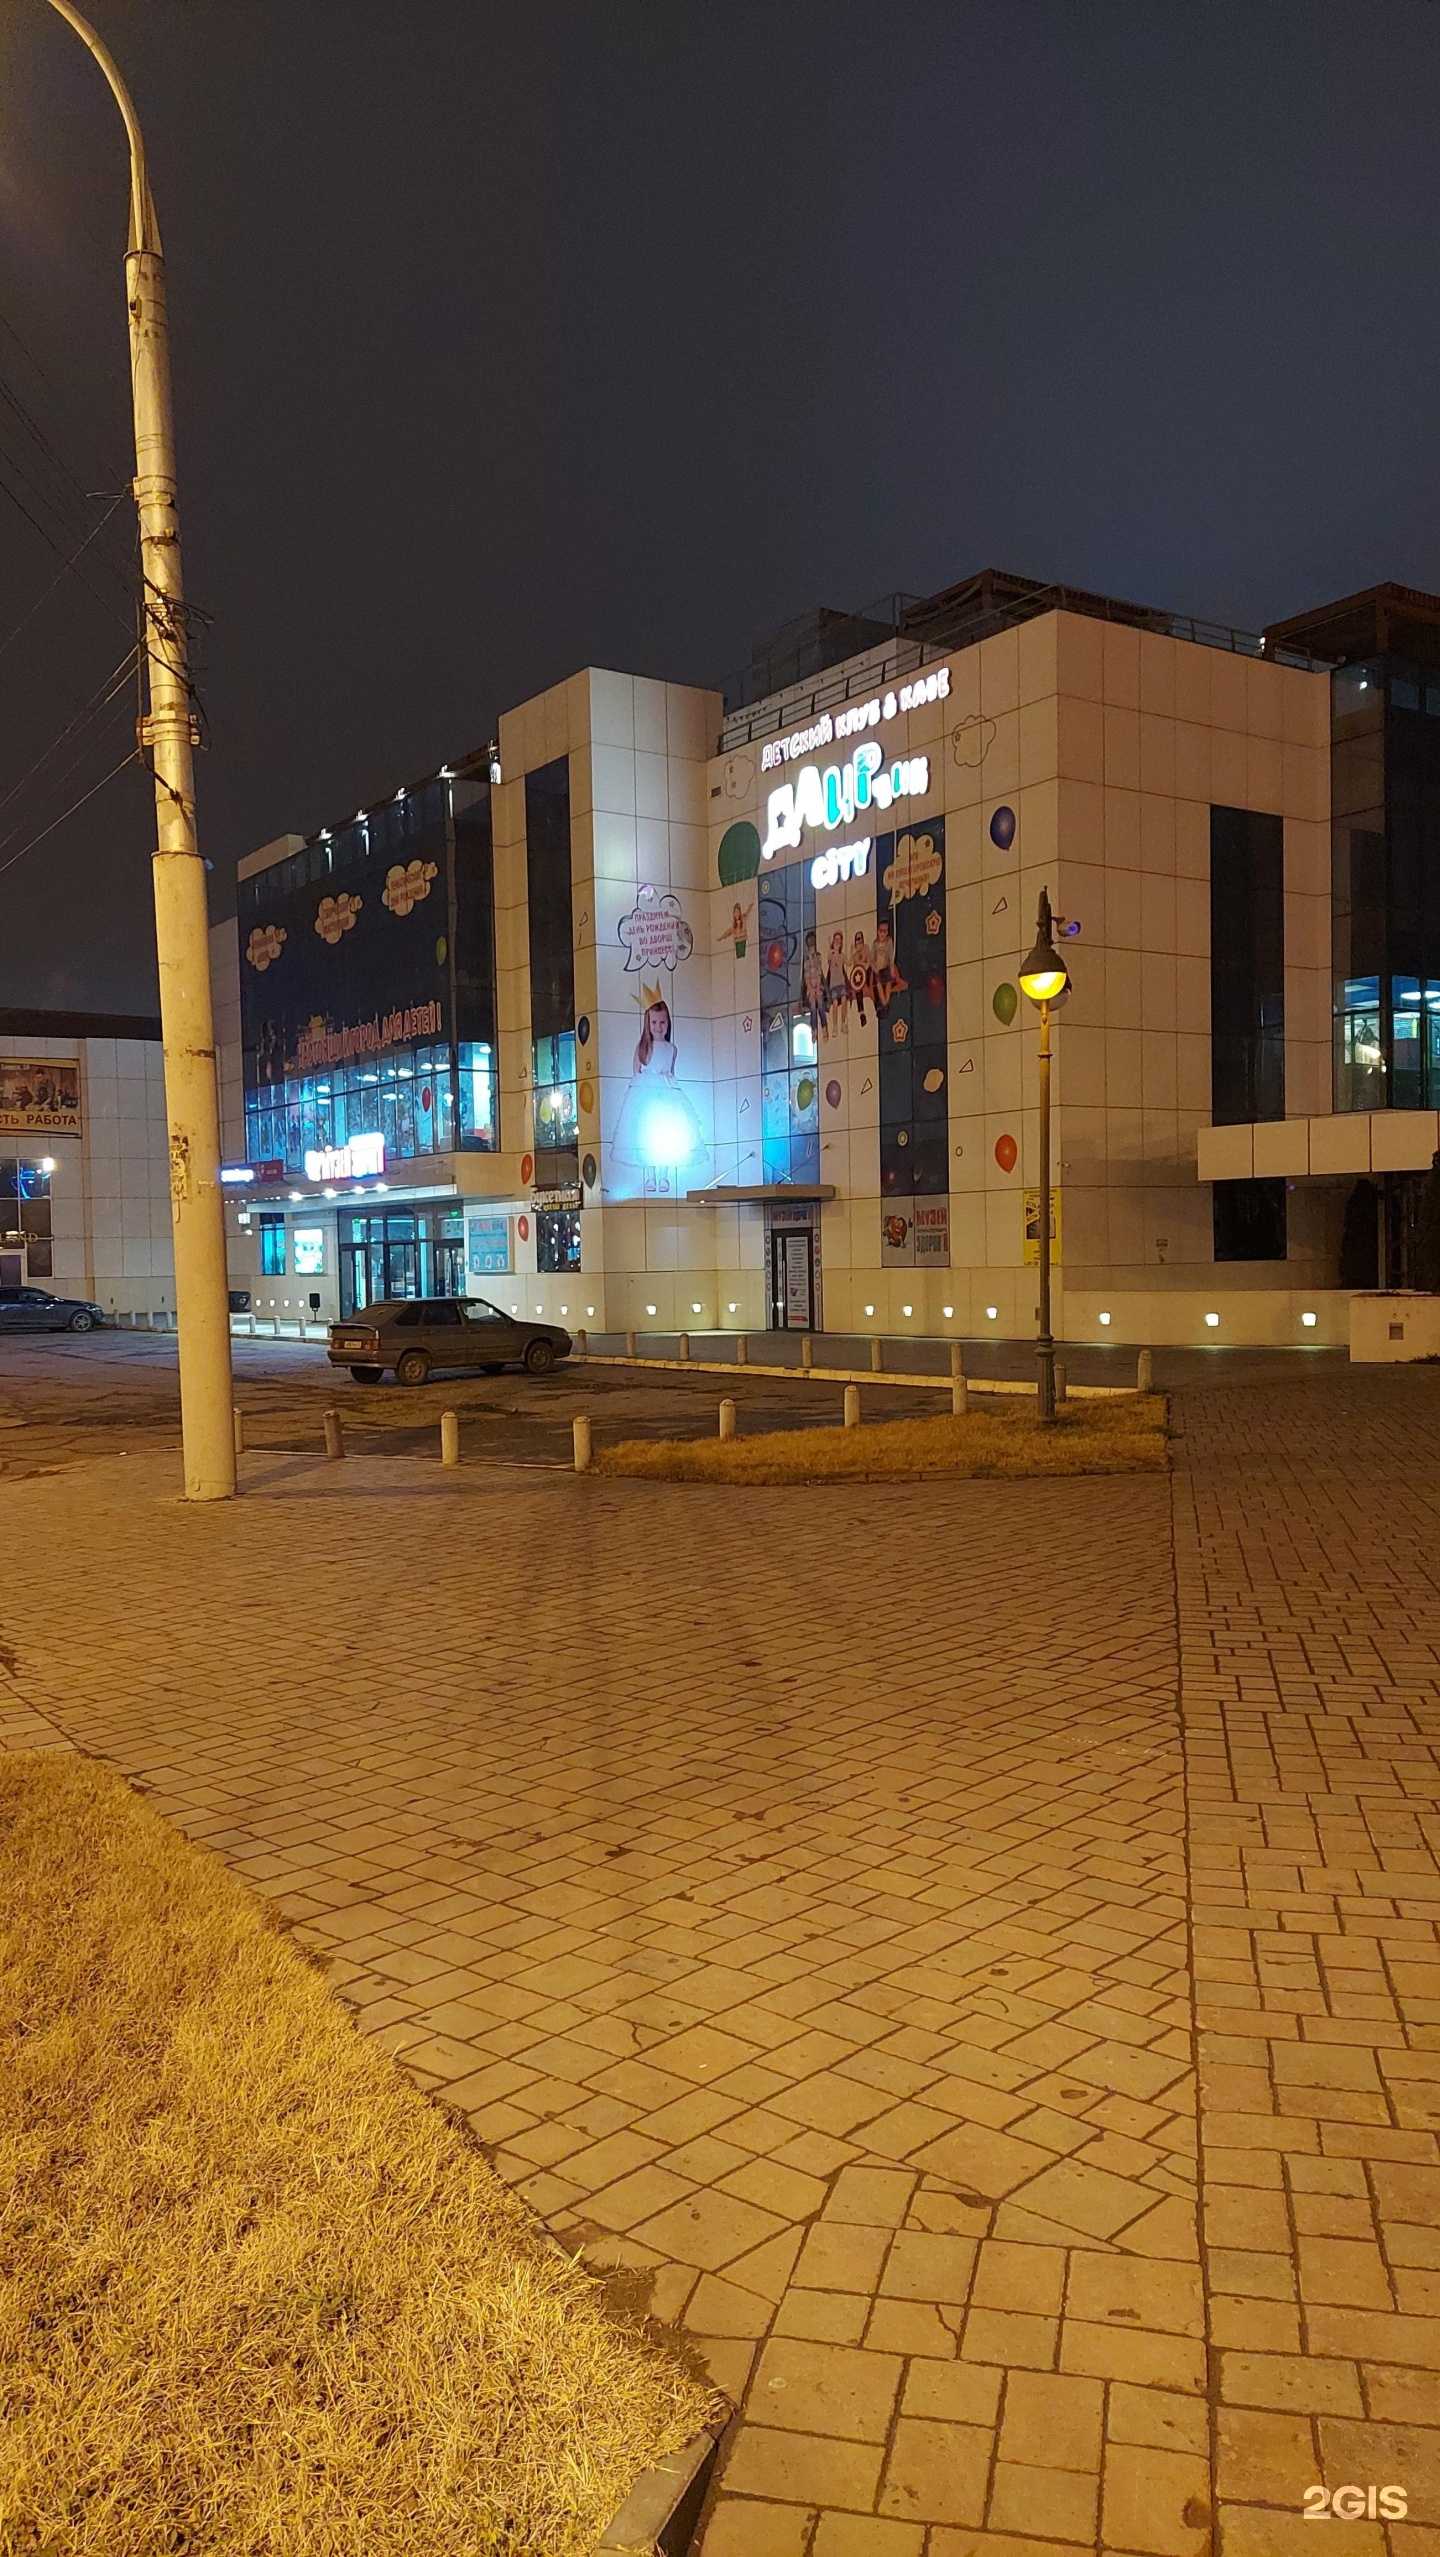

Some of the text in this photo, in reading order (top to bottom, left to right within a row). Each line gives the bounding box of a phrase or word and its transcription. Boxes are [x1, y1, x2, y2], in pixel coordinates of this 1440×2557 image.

[761, 713, 834, 773] ДЕТСКИЙ
[835, 698, 881, 739] КЛУБ
[381, 1011, 403, 1047] ДЛЯ
[26, 1114, 77, 1125] РАБОТА
